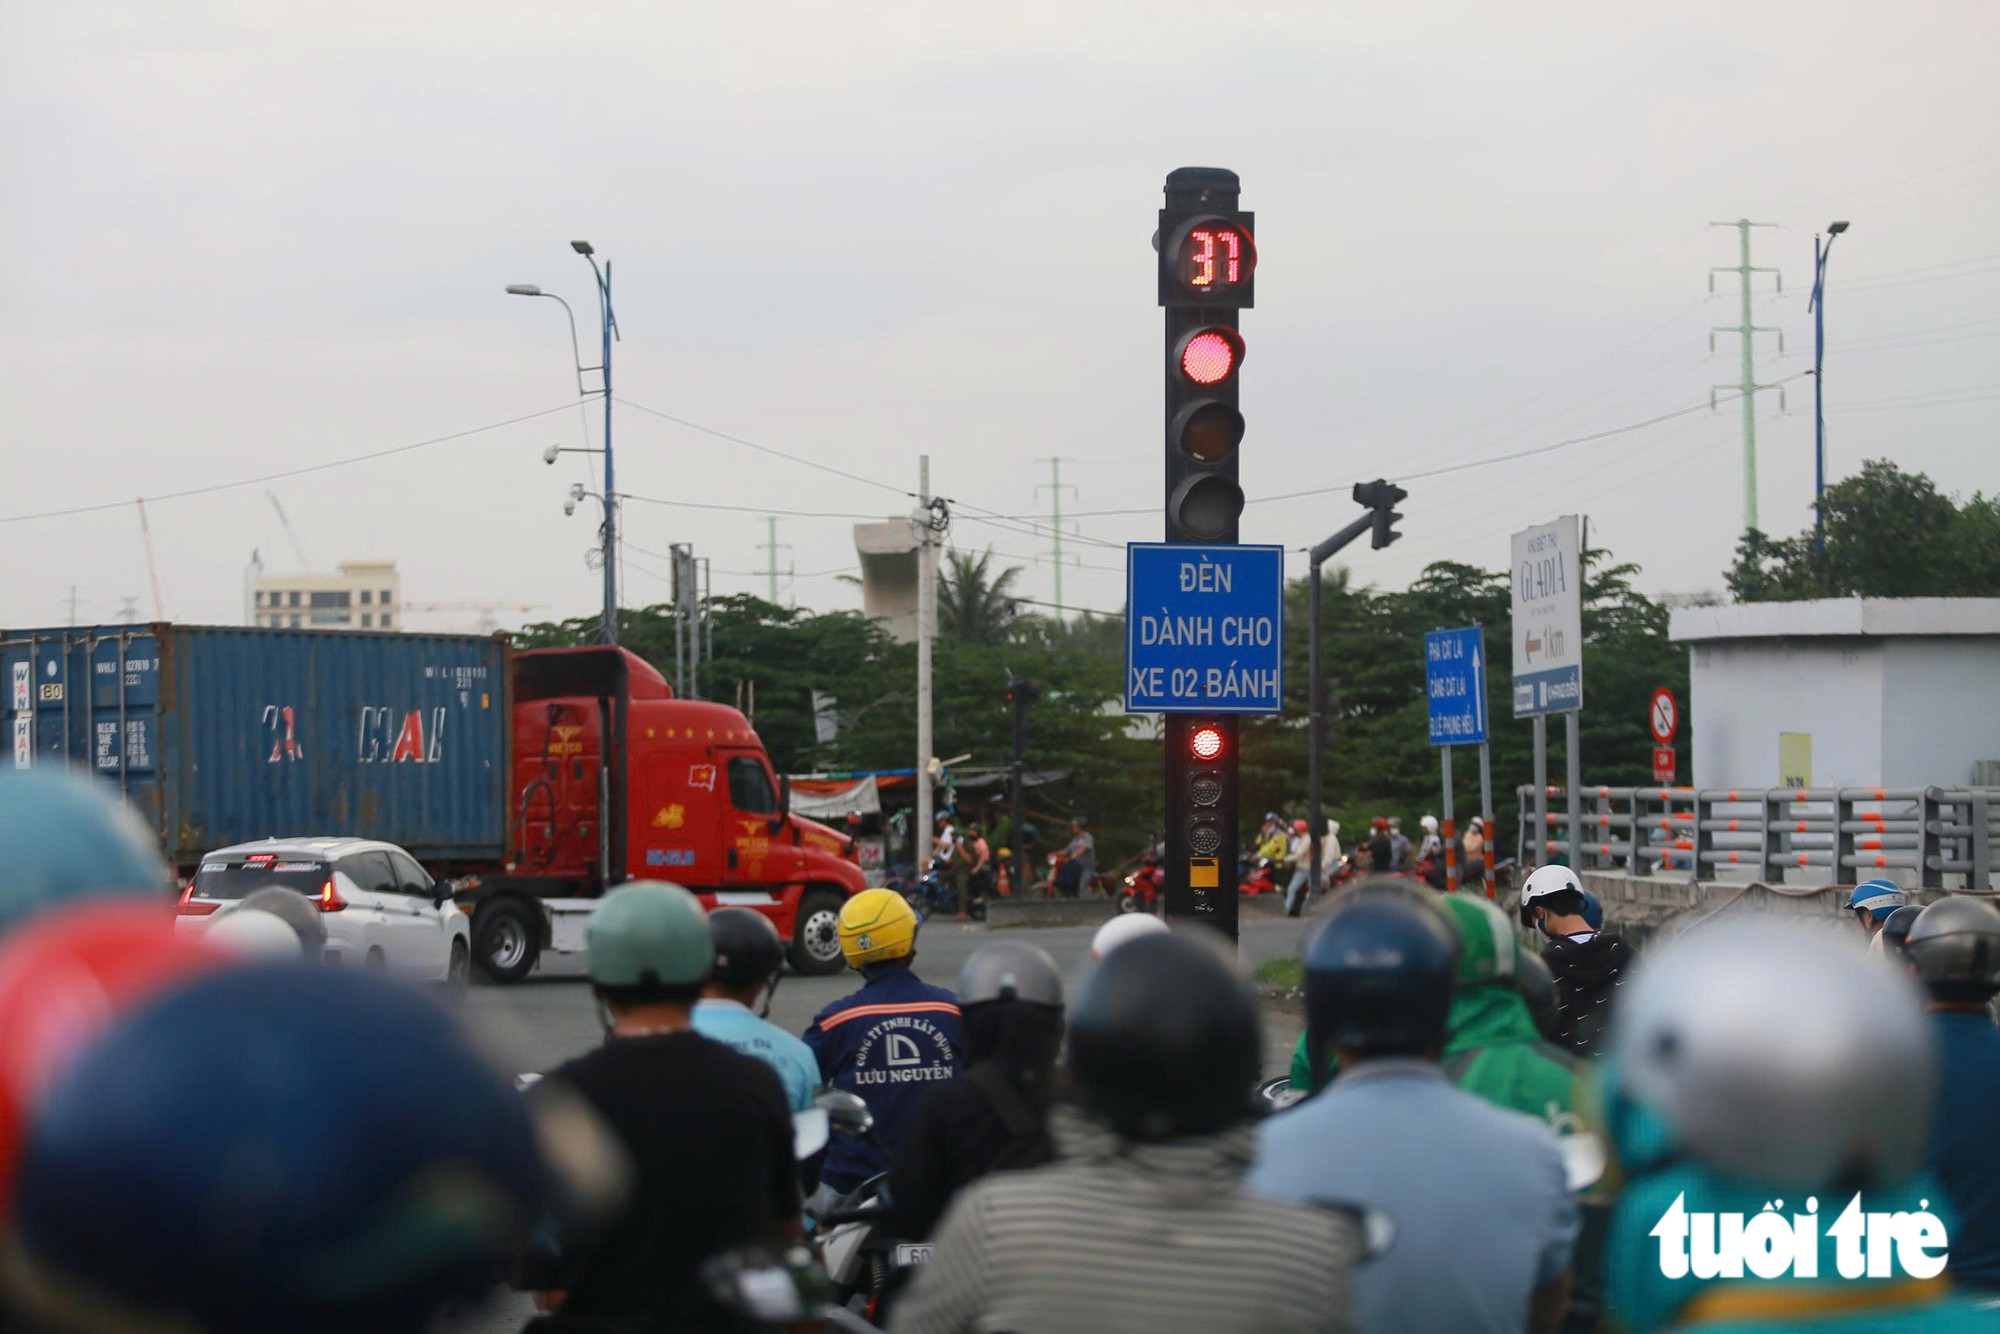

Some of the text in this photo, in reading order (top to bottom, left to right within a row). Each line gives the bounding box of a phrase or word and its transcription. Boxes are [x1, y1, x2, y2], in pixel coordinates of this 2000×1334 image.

[1192, 232, 1237, 285] 37
[1179, 554, 1232, 593] ĐÈN
[1521, 551, 1566, 603] GLADIA
[1141, 607, 1272, 646] DÀNH CHO
[1132, 660, 1278, 698] XE 02 BÁNH
[18, 723, 28, 763] HAI
[868, 1025, 882, 1040] TY
[881, 1017, 911, 1031] TNHH
[855, 1060, 953, 1084] LƯU NGUYỄN
